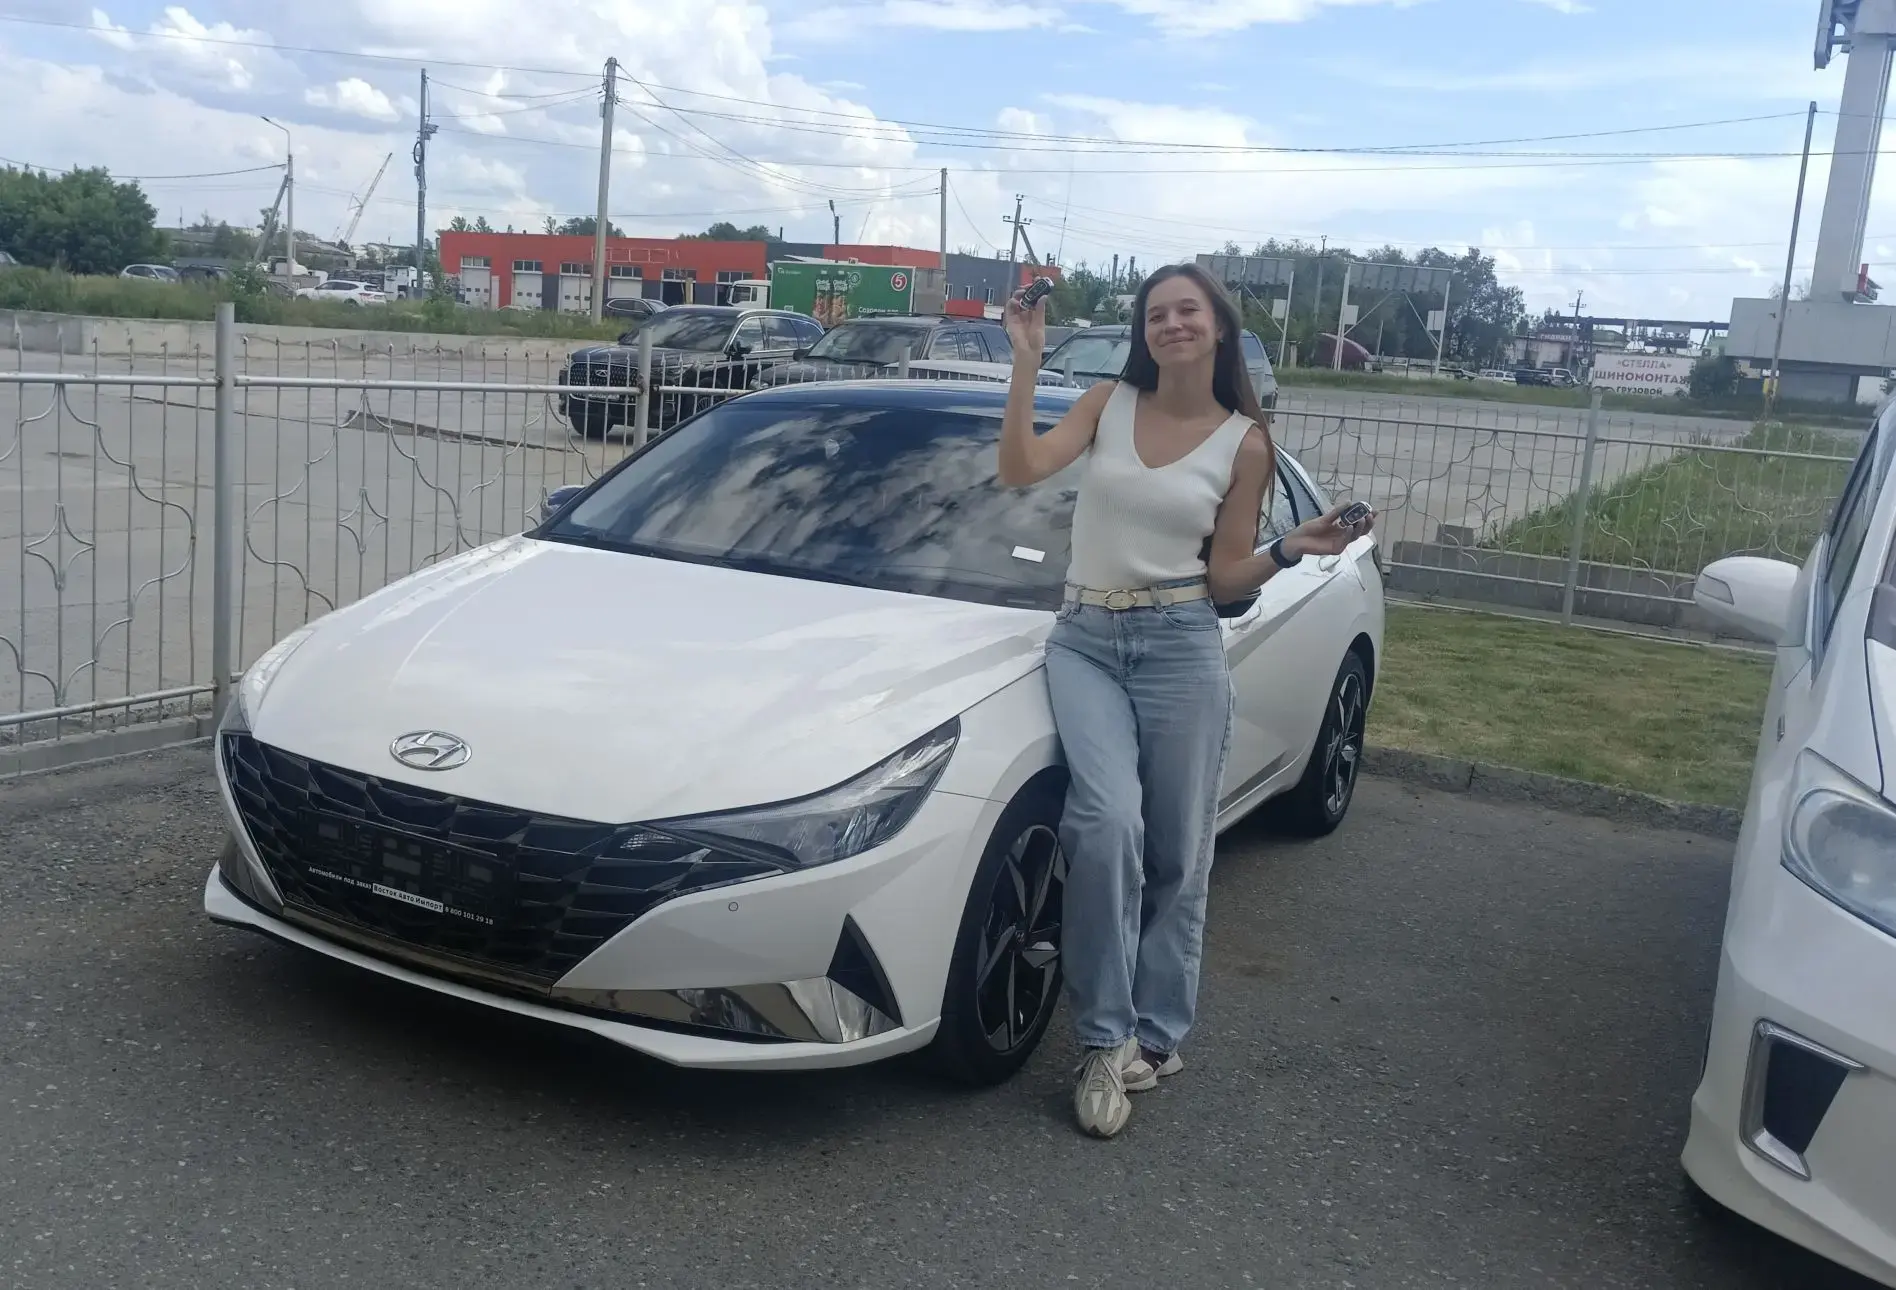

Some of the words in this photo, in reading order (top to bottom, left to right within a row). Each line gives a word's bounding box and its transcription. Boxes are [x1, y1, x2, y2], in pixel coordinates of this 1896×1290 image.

[1616, 386, 1663, 396] ГРУЗОВОЙ
[308, 866, 343, 880] Автомобили
[343, 877, 355, 886] под
[356, 880, 372, 890] заказ
[373, 885, 397, 897] Восток
[415, 897, 442, 911] Импорт
[463, 911, 474, 921] 101
[475, 915, 484, 923] 29
